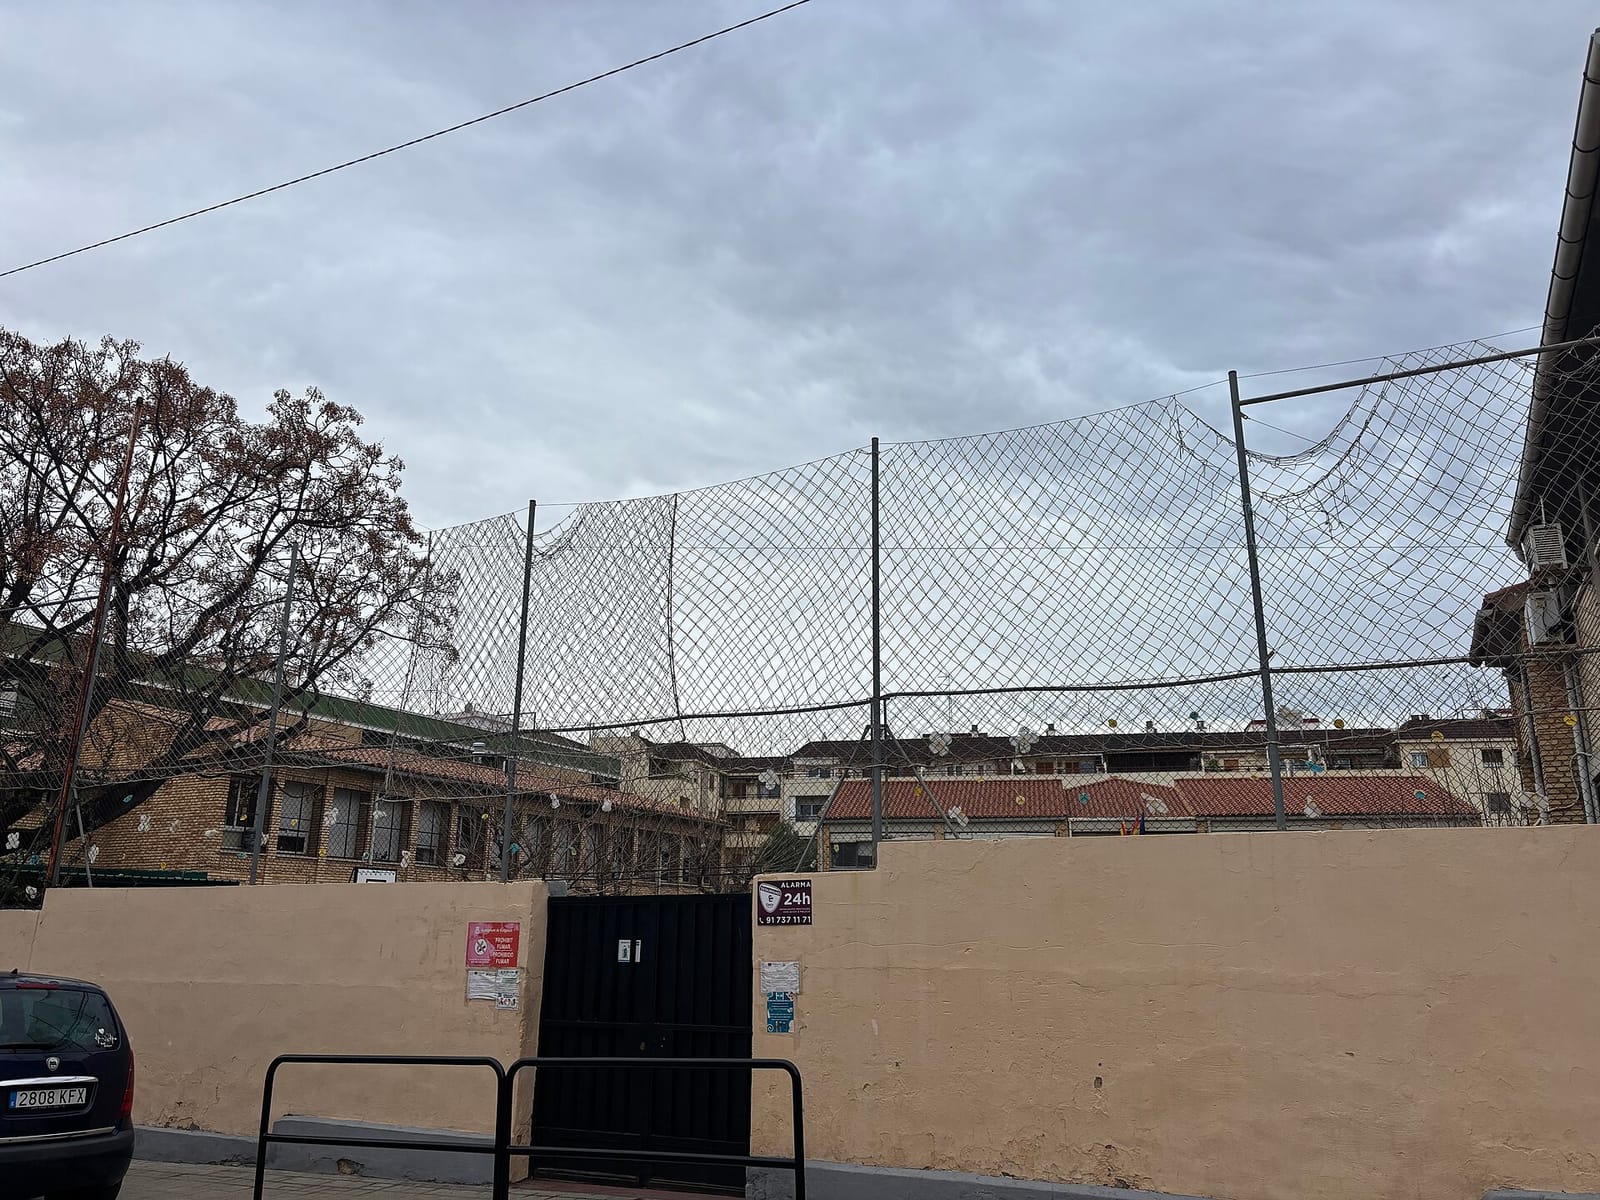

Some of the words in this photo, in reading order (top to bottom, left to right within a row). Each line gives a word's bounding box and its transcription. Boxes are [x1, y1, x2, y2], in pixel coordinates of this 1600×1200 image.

[784, 893, 811, 905] 24h
[19, 1091, 55, 1106] 2808
[59, 1088, 85, 1104] KFX
